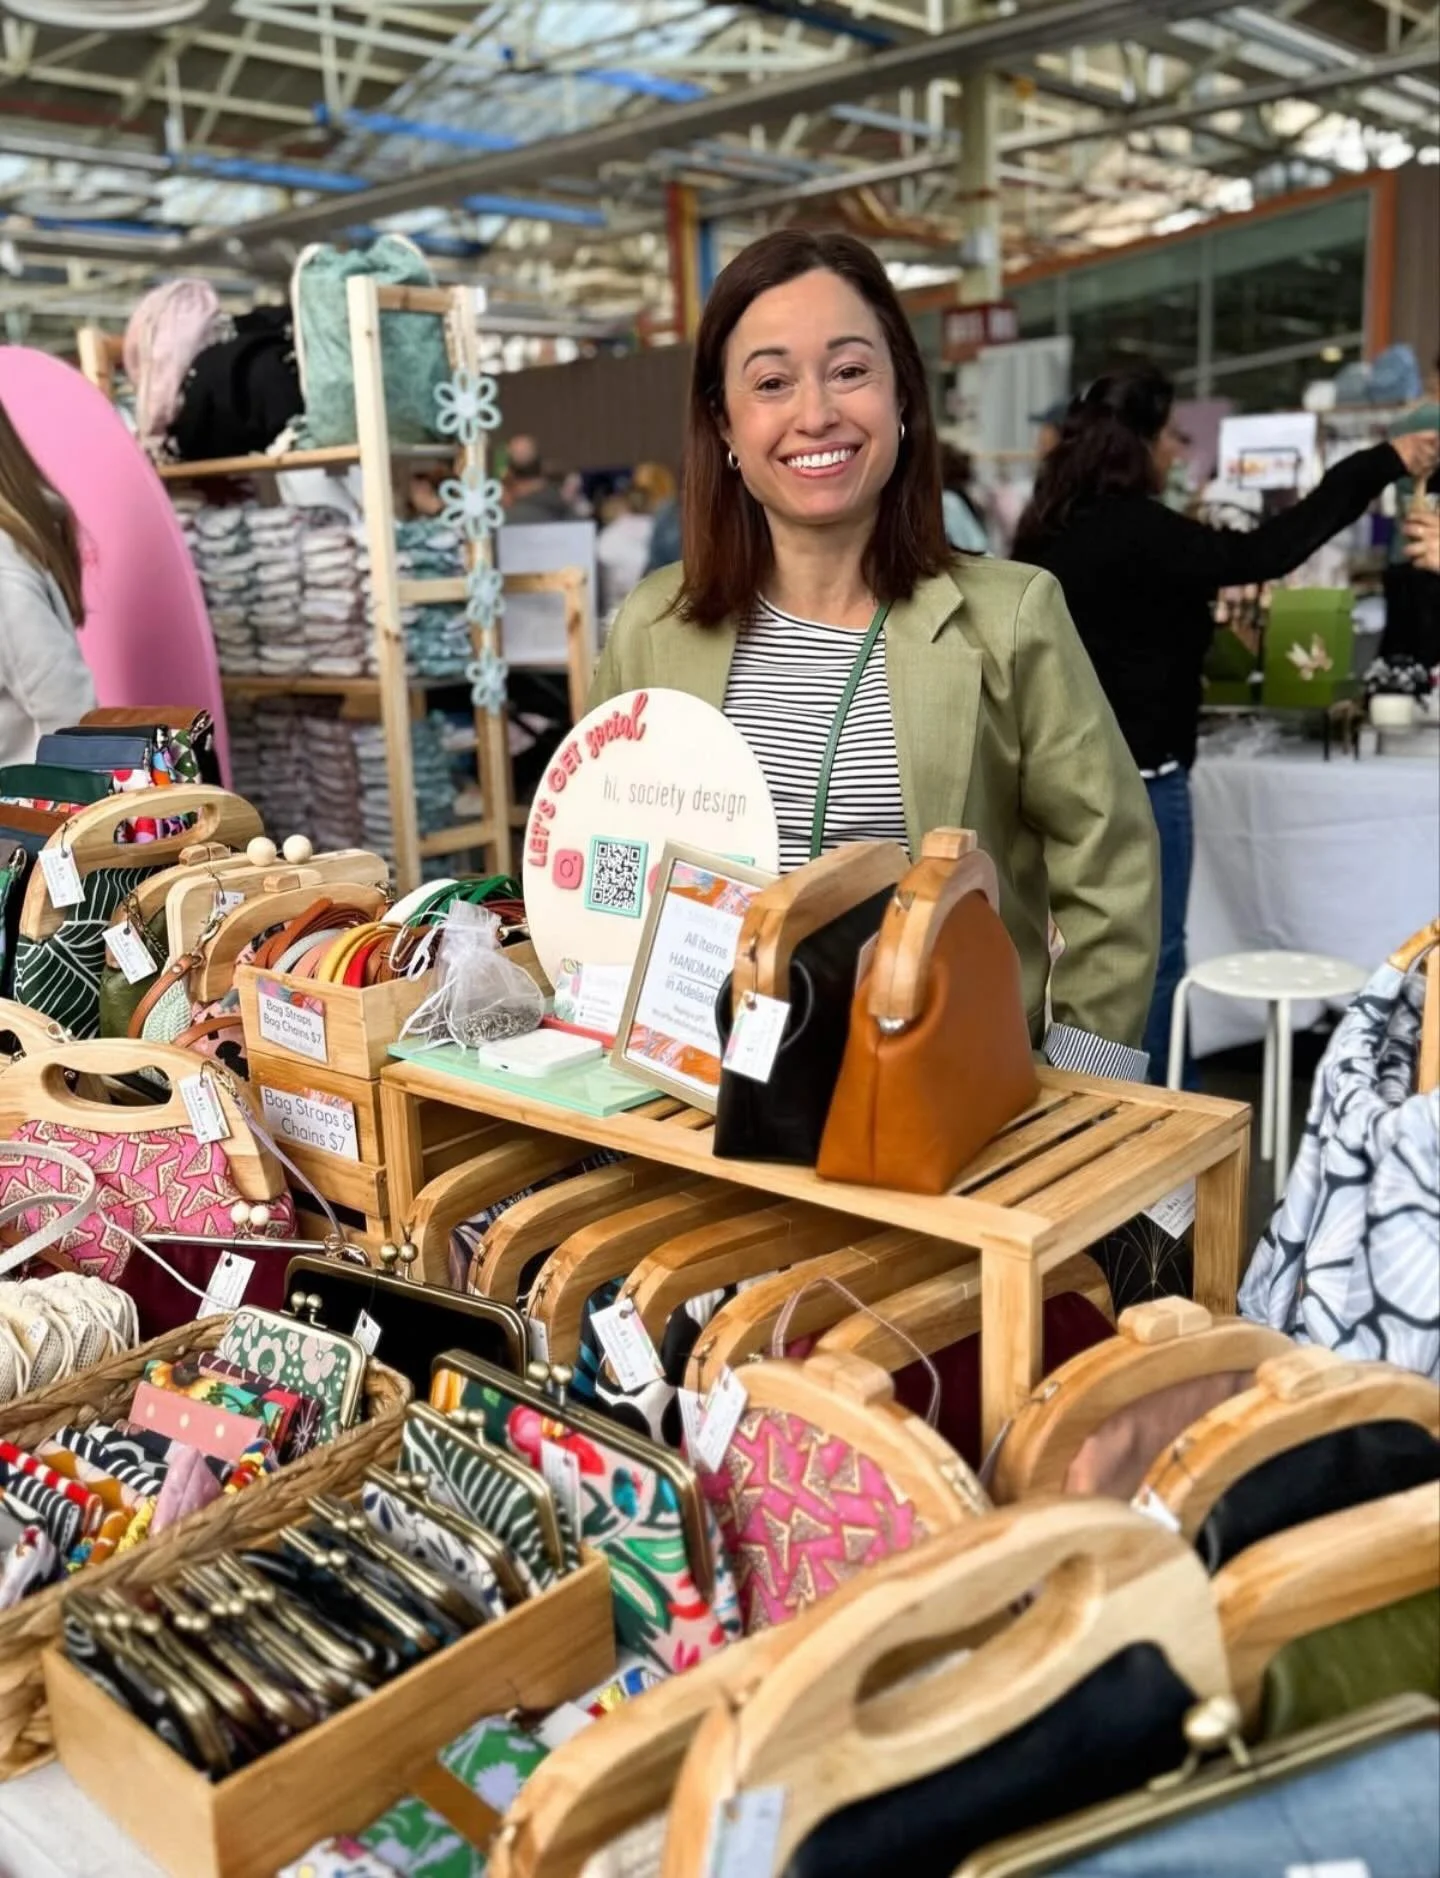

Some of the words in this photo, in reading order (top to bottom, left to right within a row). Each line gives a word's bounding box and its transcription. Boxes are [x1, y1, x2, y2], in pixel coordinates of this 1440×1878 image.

[528, 799, 557, 868] LET'S
[547, 740, 583, 793] GET
[585, 691, 648, 759] social
[603, 774, 620, 804] hi,
[629, 782, 685, 816] society
[692, 784, 747, 822] design
[684, 931, 699, 947] All
[698, 937, 728, 960] items
[669, 951, 725, 985] HANDMAD
[665, 975, 675, 991] in
[676, 980, 715, 1007] Adelaid
[263, 1012, 281, 1031] Bag
[281, 1020, 310, 1041] Chains
[311, 1031, 322, 1044] $7
[266, 999, 284, 1018] Bag
[285, 1006, 312, 1026] Straps
[264, 1089, 292, 1115] Bag
[295, 1098, 339, 1127] Straps
[342, 1113, 353, 1131] &
[281, 1117, 326, 1147] Chains
[329, 1131, 346, 1152] $7
